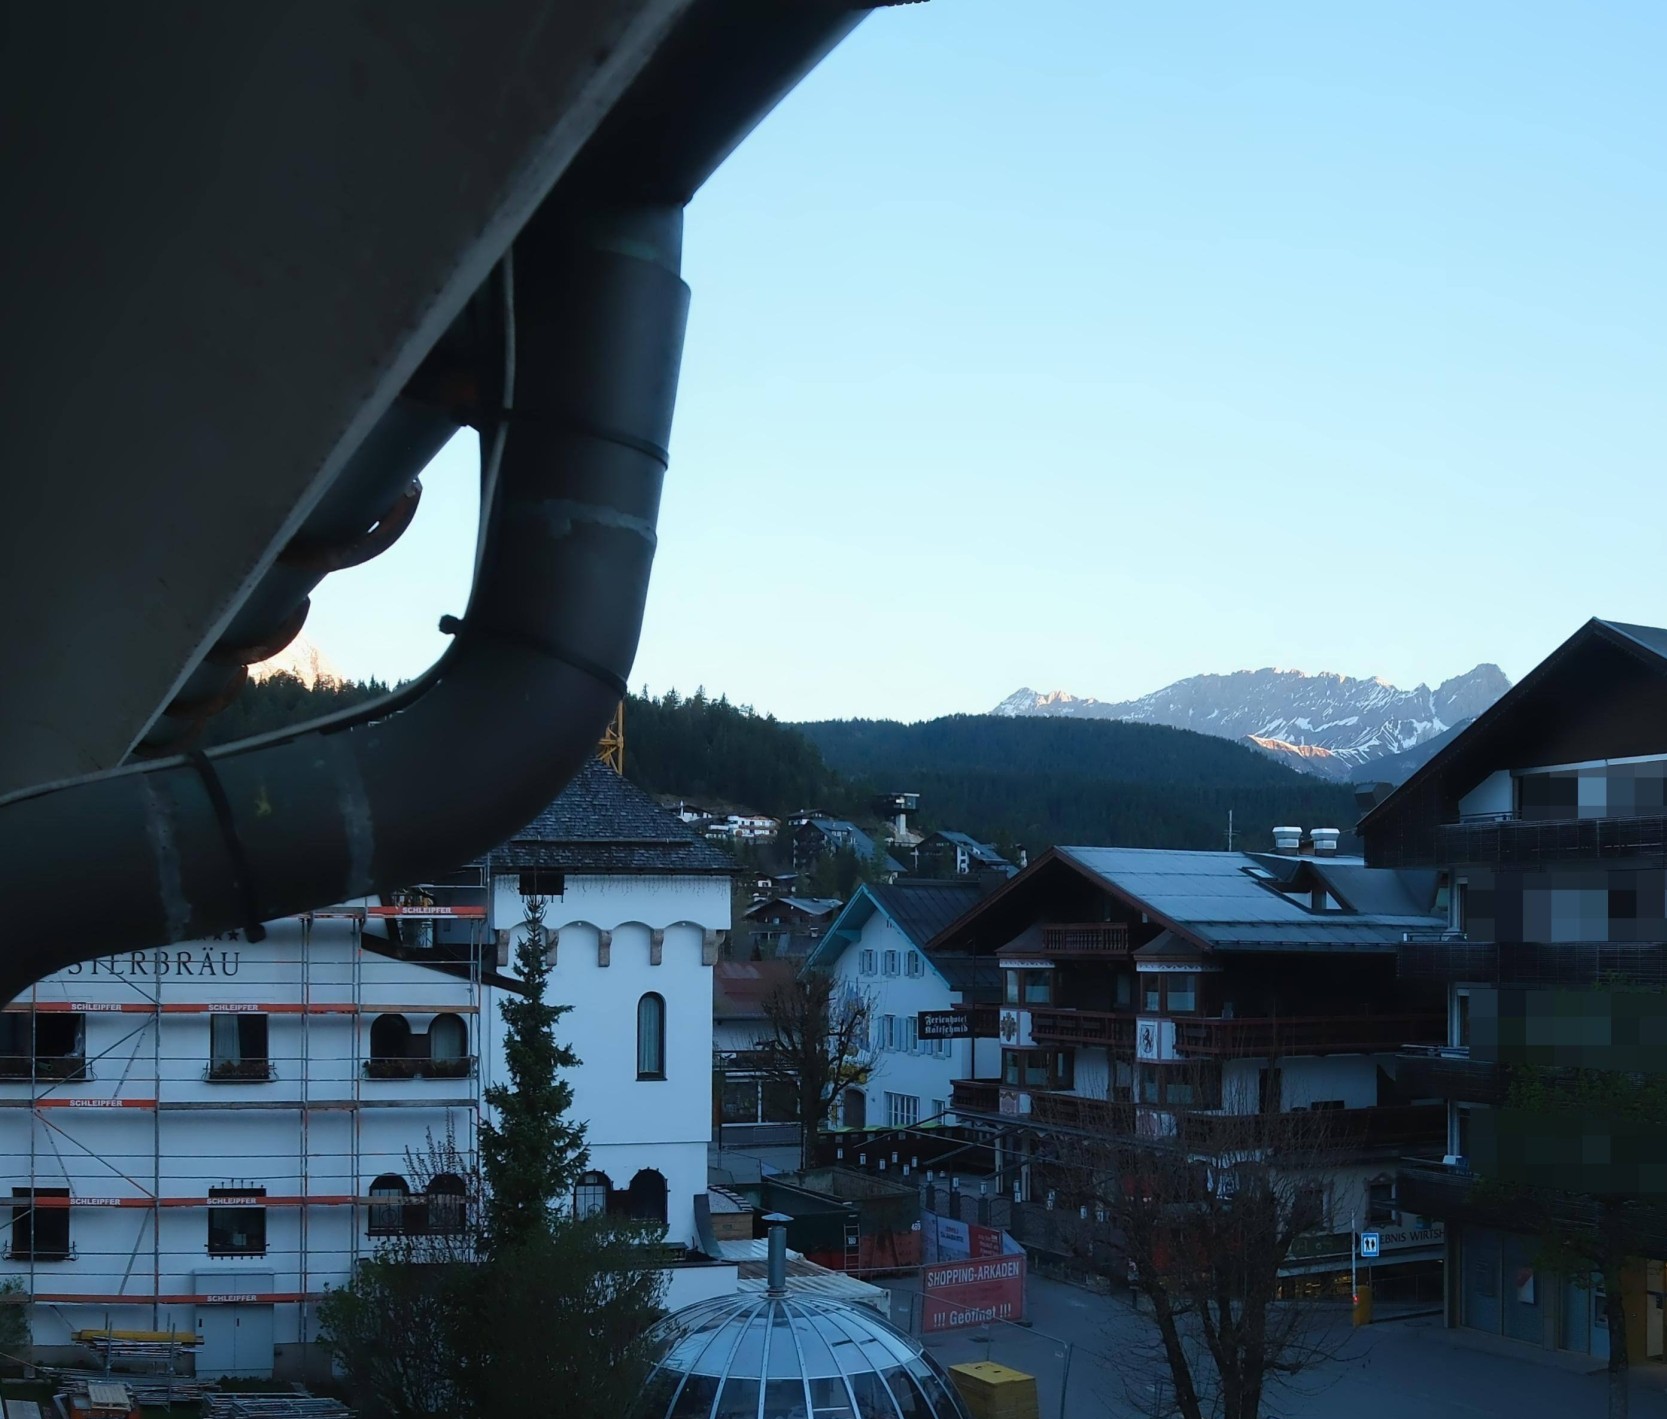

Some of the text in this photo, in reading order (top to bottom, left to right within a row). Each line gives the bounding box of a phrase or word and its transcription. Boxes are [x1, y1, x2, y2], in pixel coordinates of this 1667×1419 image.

[402, 906, 452, 914] SCHLEIPFER
[71, 1003, 122, 1011] SCHLEIPFER
[208, 1003, 259, 1011] SCHLEIPFER
[69, 1099, 123, 1107] SCHLEIPFER
[69, 1198, 121, 1206] SCHLEIPFER
[206, 1197, 257, 1205] SCHLEIPFER
[927, 1262, 1020, 1287] SHOPPING-ARKADEN
[206, 1294, 257, 1302] SCHLEIPFER
